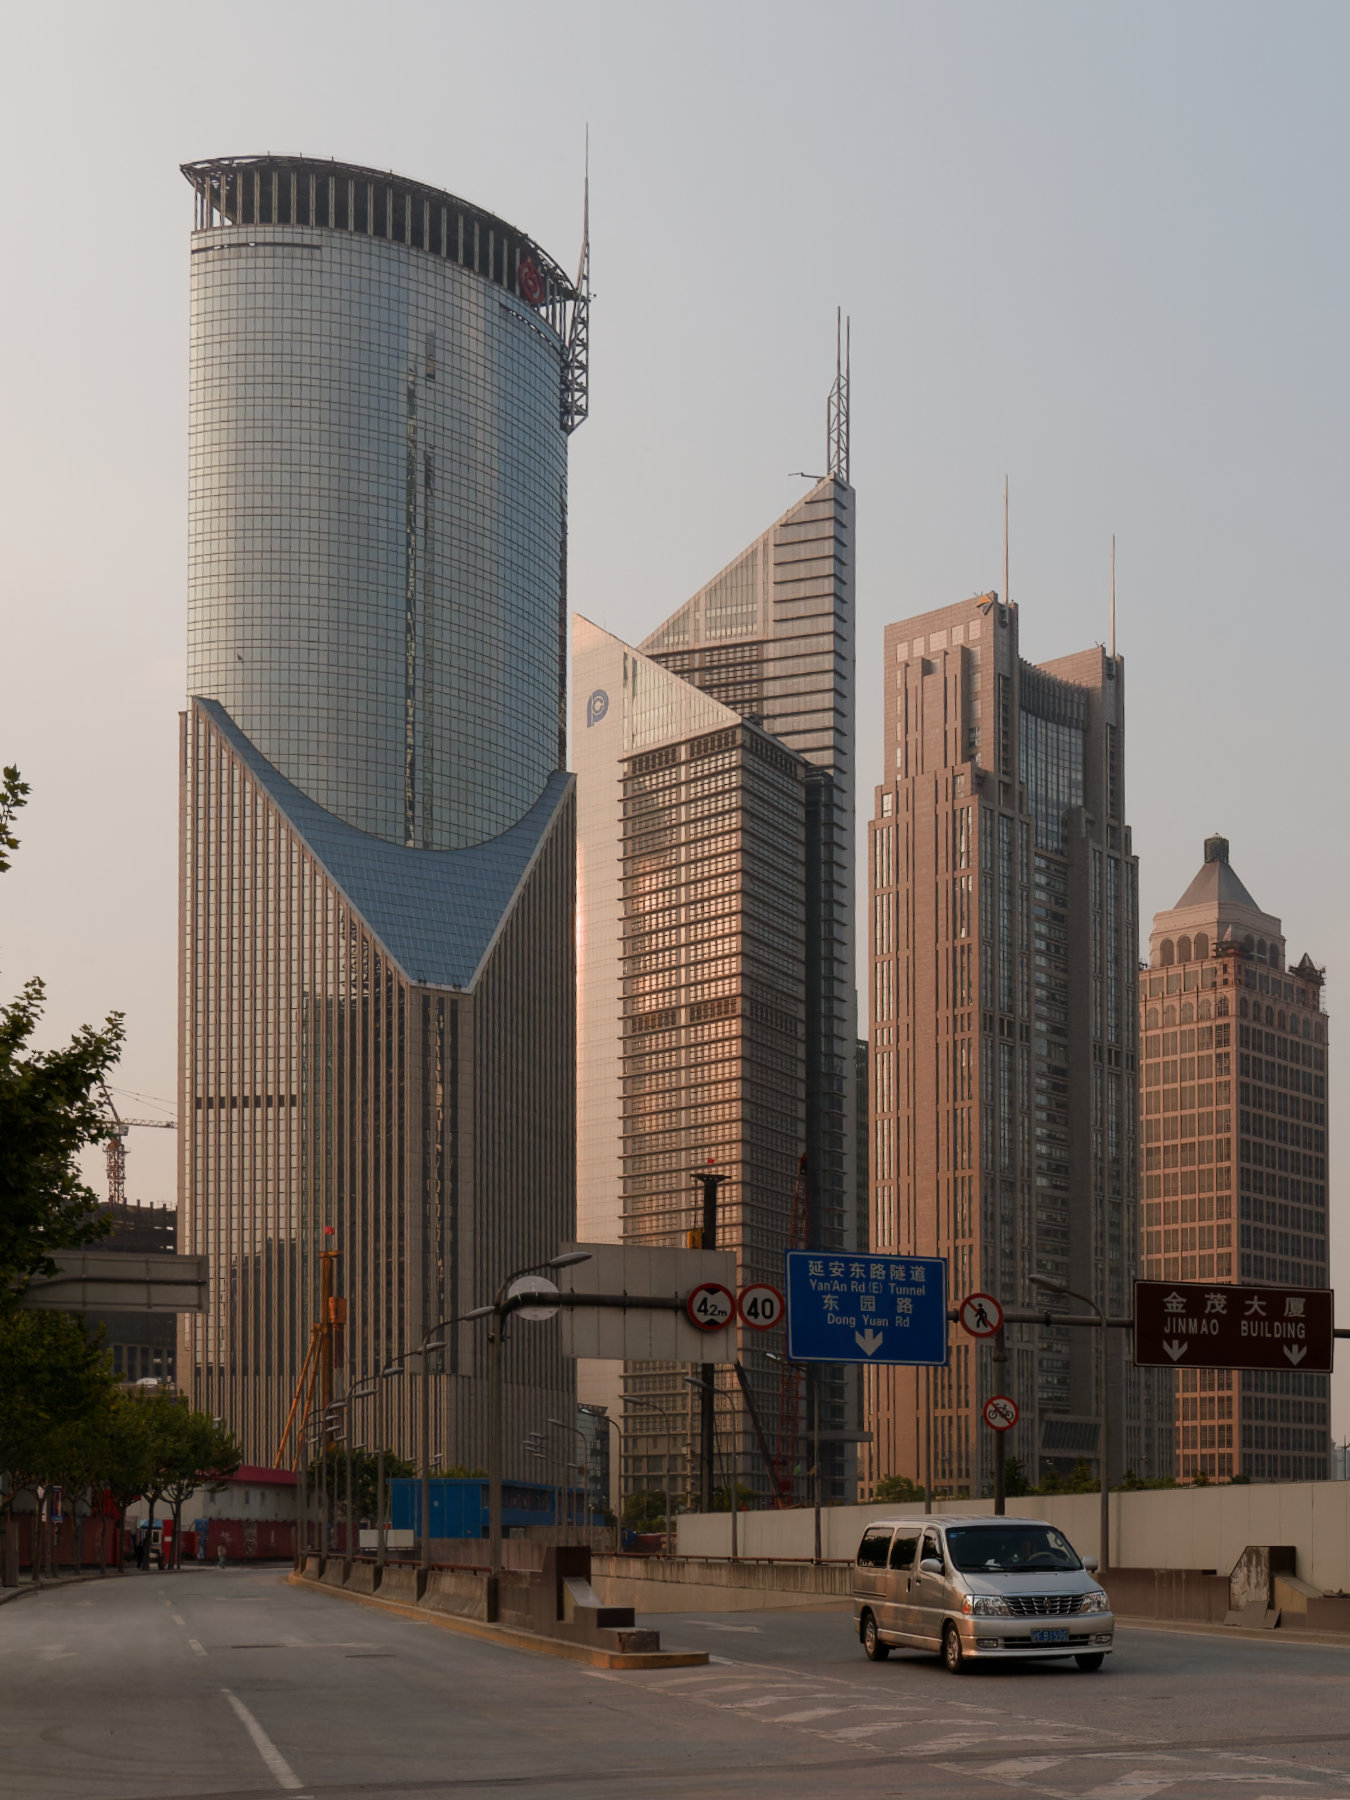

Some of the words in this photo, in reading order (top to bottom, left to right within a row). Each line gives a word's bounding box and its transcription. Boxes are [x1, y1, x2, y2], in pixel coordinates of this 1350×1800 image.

[808, 1260, 926, 1282] 延安东路隧道
[809, 1279, 847, 1292] Yan'An
[851, 1281, 866, 1293] Rd
[868, 1281, 883, 1294] (E)
[889, 1283, 926, 1296] Tunnel
[747, 1297, 774, 1319] 40
[822, 1294, 913, 1315] 东园路
[1163, 1291, 1307, 1318] 金茂大厦
[827, 1313, 856, 1328] Dong
[862, 1314, 889, 1327] Yuan
[895, 1316, 910, 1328] Rd
[1164, 1317, 1219, 1335] JINMAO
[1240, 1320, 1306, 1339] BUILDING
